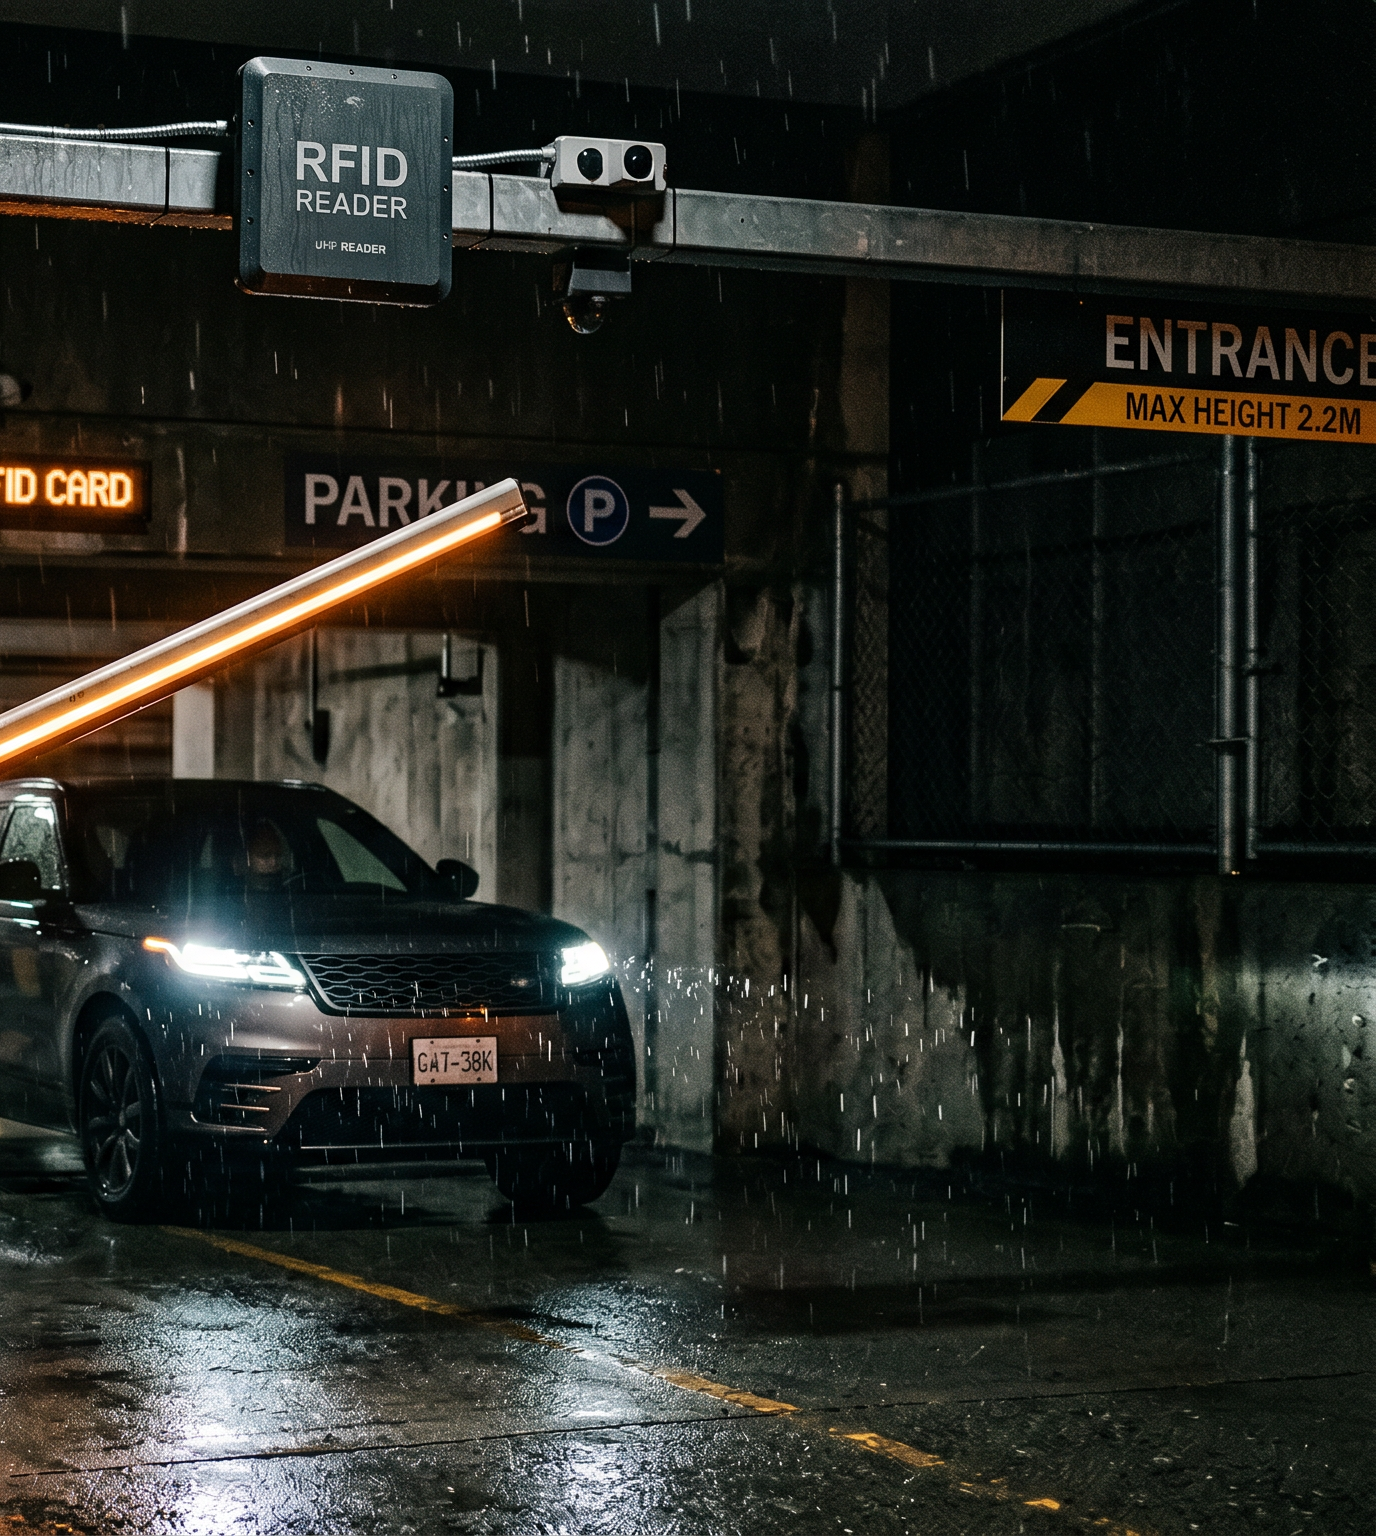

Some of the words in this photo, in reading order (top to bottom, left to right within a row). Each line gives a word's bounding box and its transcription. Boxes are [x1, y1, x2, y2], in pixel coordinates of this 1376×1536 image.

[296, 140, 408, 187] RFID
[296, 189, 407, 219] READER
[340, 242, 386, 254] READER
[1106, 314, 1376, 386] ENTRANCE
[1126, 392, 1186, 423] MAX
[1193, 396, 1291, 430] HEIGHT
[1297, 403, 1361, 435] 2.2M
[45, 468, 132, 507] CARD
[304, 473, 547, 534] PARKG
[583, 488, 616, 533] P
[417, 1050, 493, 1073] GAT-38K
